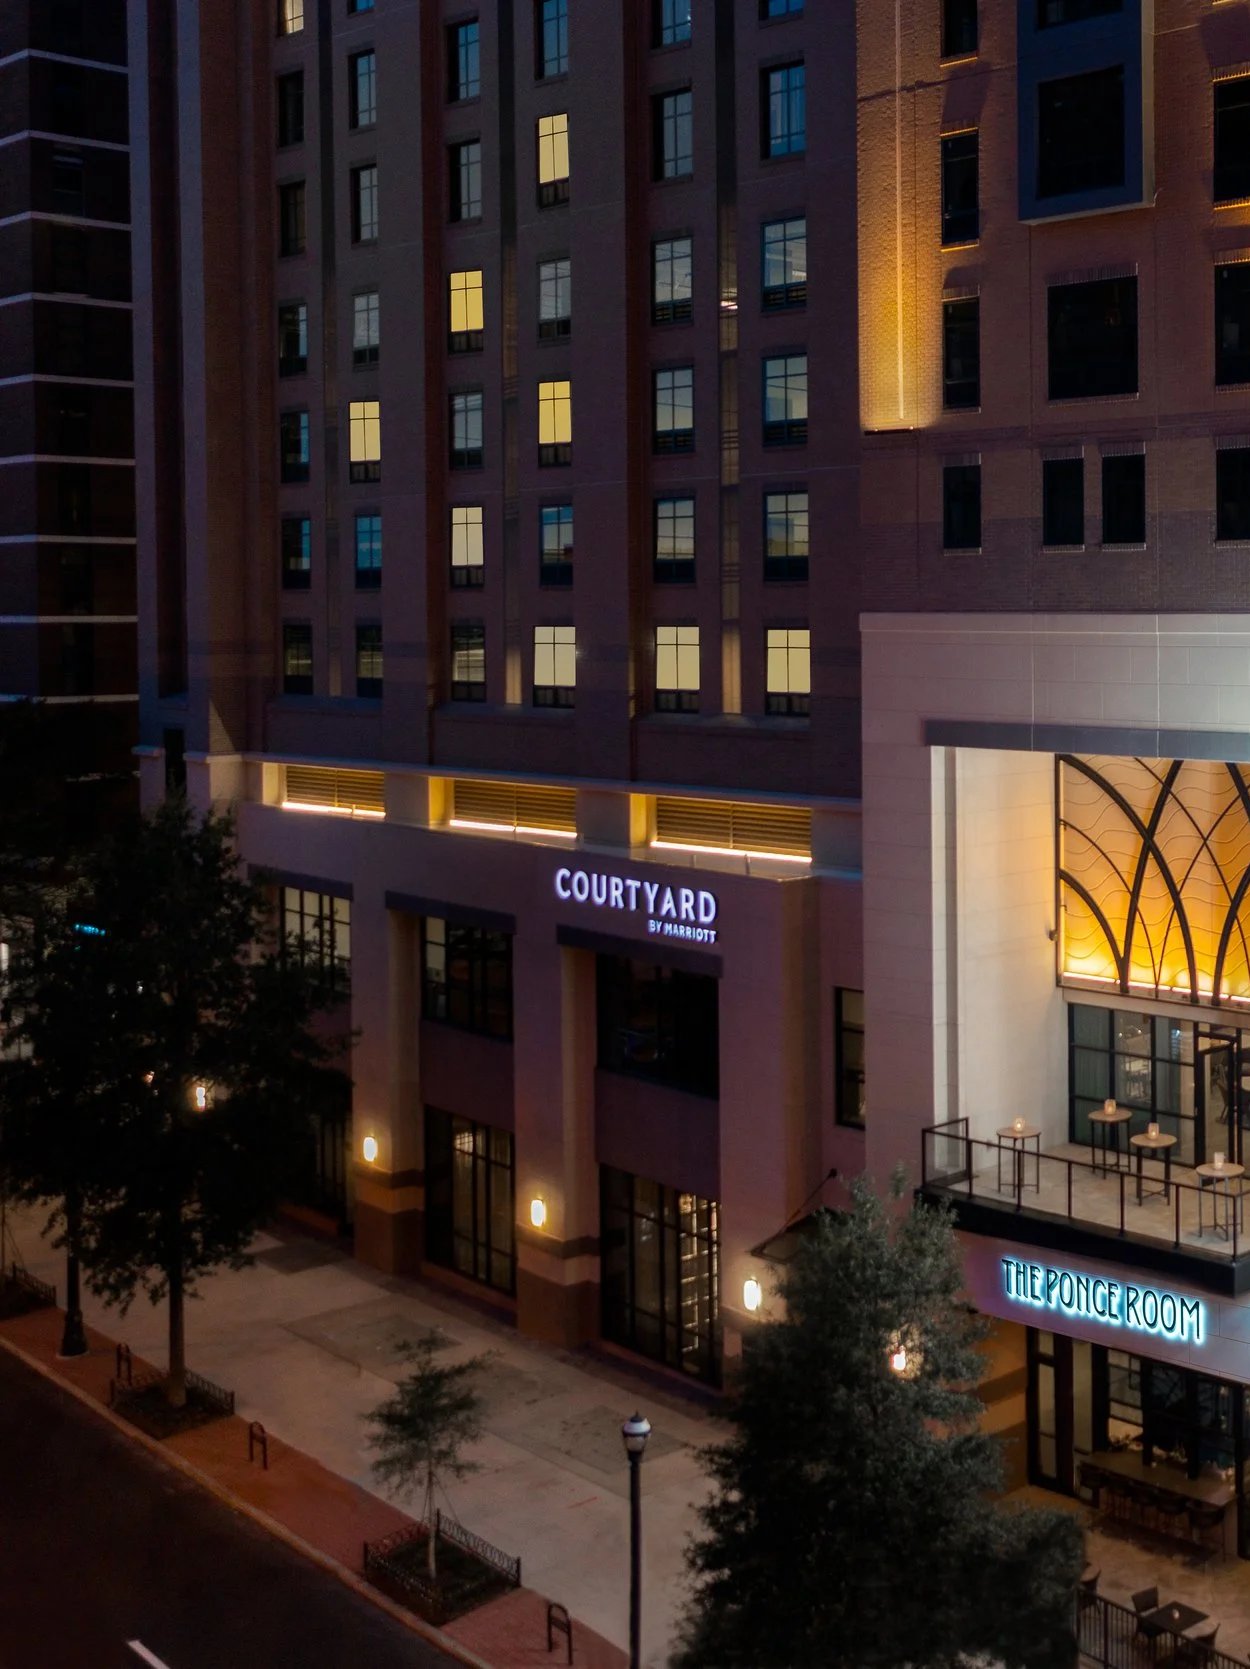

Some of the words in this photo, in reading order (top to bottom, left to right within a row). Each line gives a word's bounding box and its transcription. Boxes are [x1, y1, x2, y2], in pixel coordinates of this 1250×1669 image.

[556, 867, 717, 925] COURTYARD
[648, 919, 663, 934] BY
[663, 922, 717, 944] MARRIOTT
[1001, 1258, 1042, 1302] THE
[1046, 1268, 1120, 1321] PONCE
[1125, 1285, 1202, 1341] ROOM
